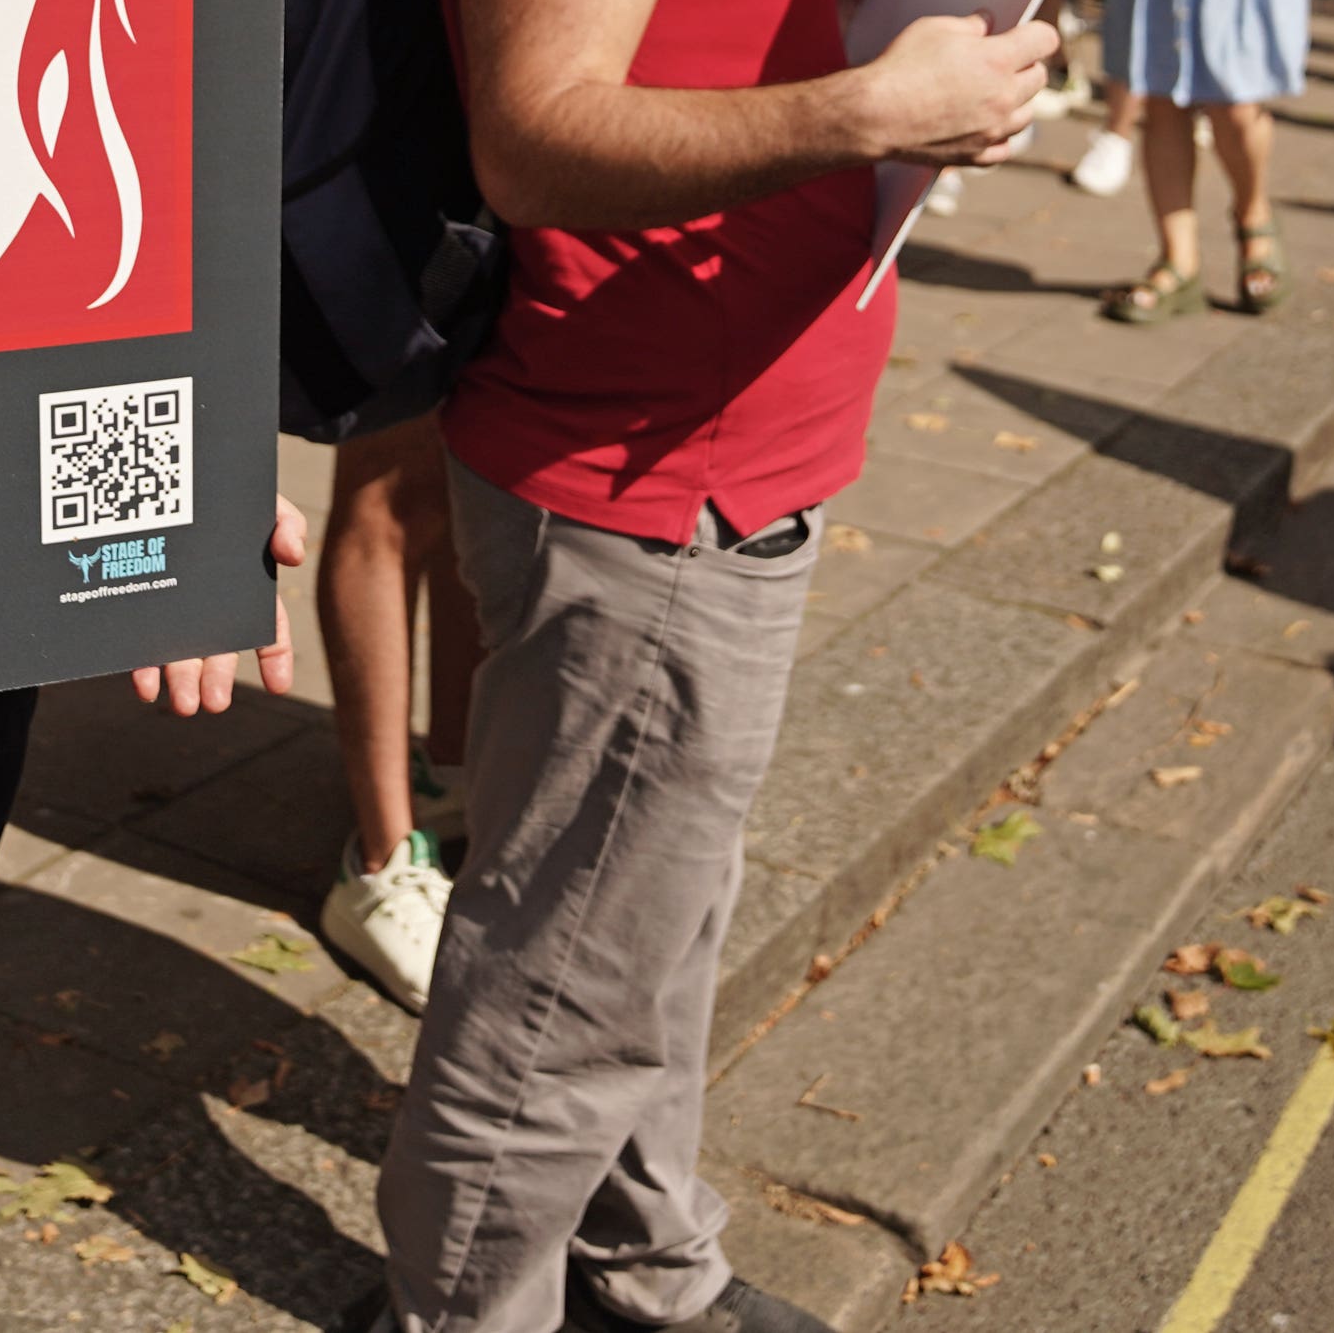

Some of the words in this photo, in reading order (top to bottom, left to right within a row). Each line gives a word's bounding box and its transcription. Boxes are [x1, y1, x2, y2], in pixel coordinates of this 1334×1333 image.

[101, 539, 144, 562] STAGE
[147, 536, 166, 555] OF
[101, 553, 166, 580] FREEDOM
[60, 577, 178, 604] stageoffreedom.com
